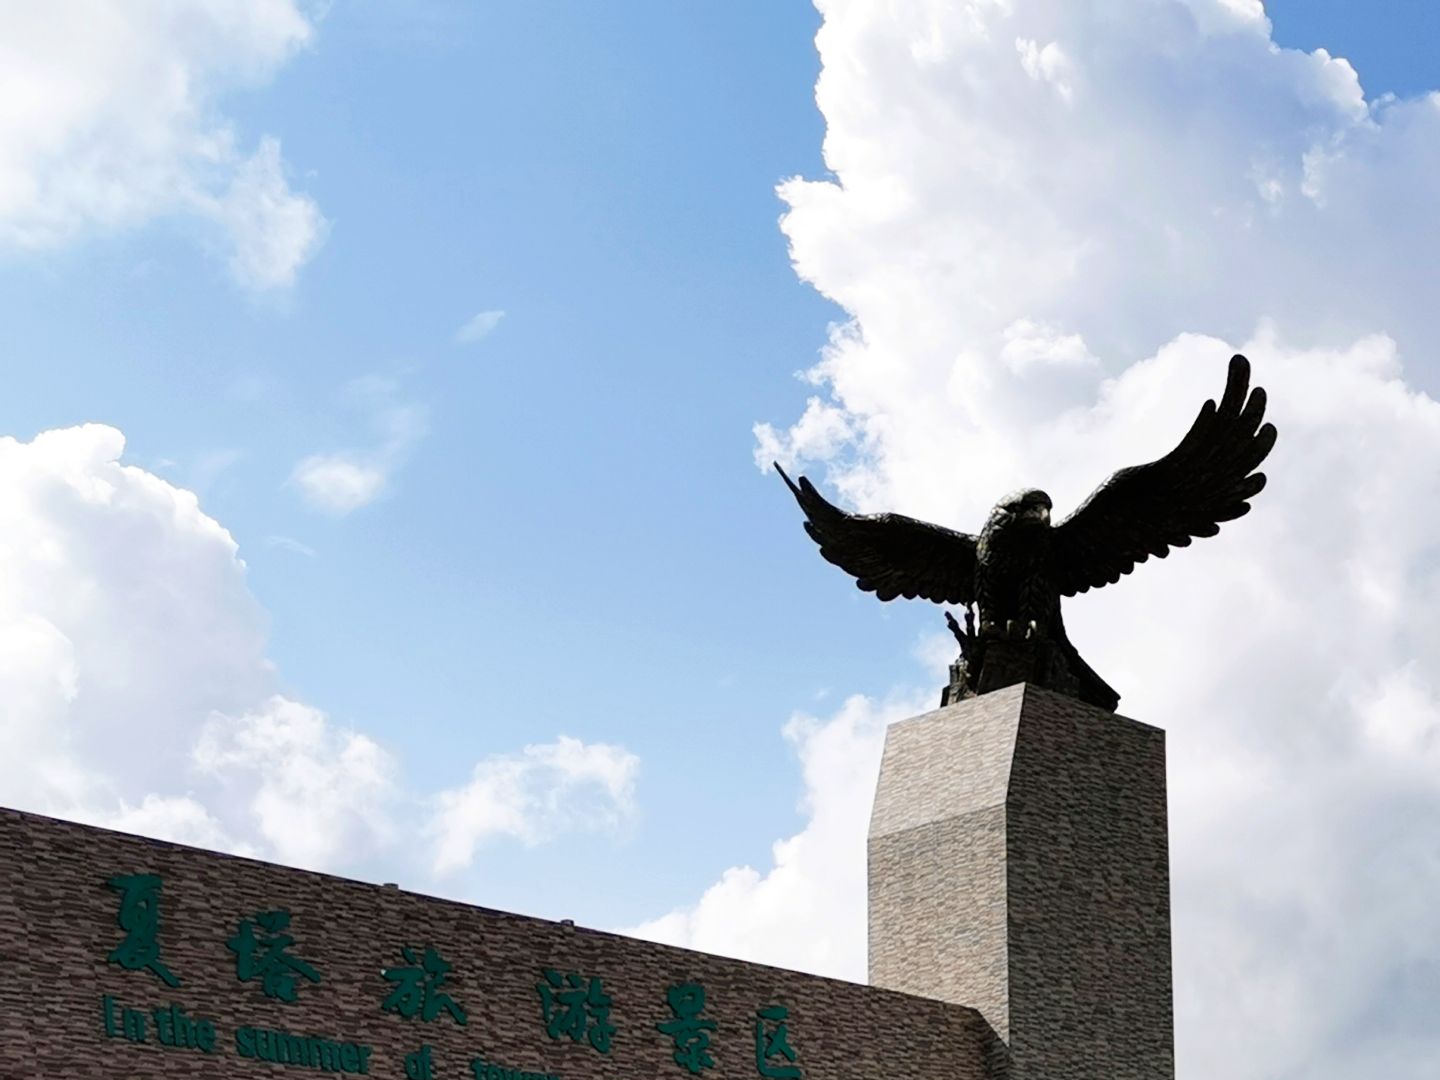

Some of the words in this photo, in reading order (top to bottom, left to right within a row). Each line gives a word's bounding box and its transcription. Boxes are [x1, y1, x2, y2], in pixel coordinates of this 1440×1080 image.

[107, 873, 802, 1080] 夏塔旅游景区
[153, 1006, 216, 1053] the
[236, 1026, 372, 1073] summer
